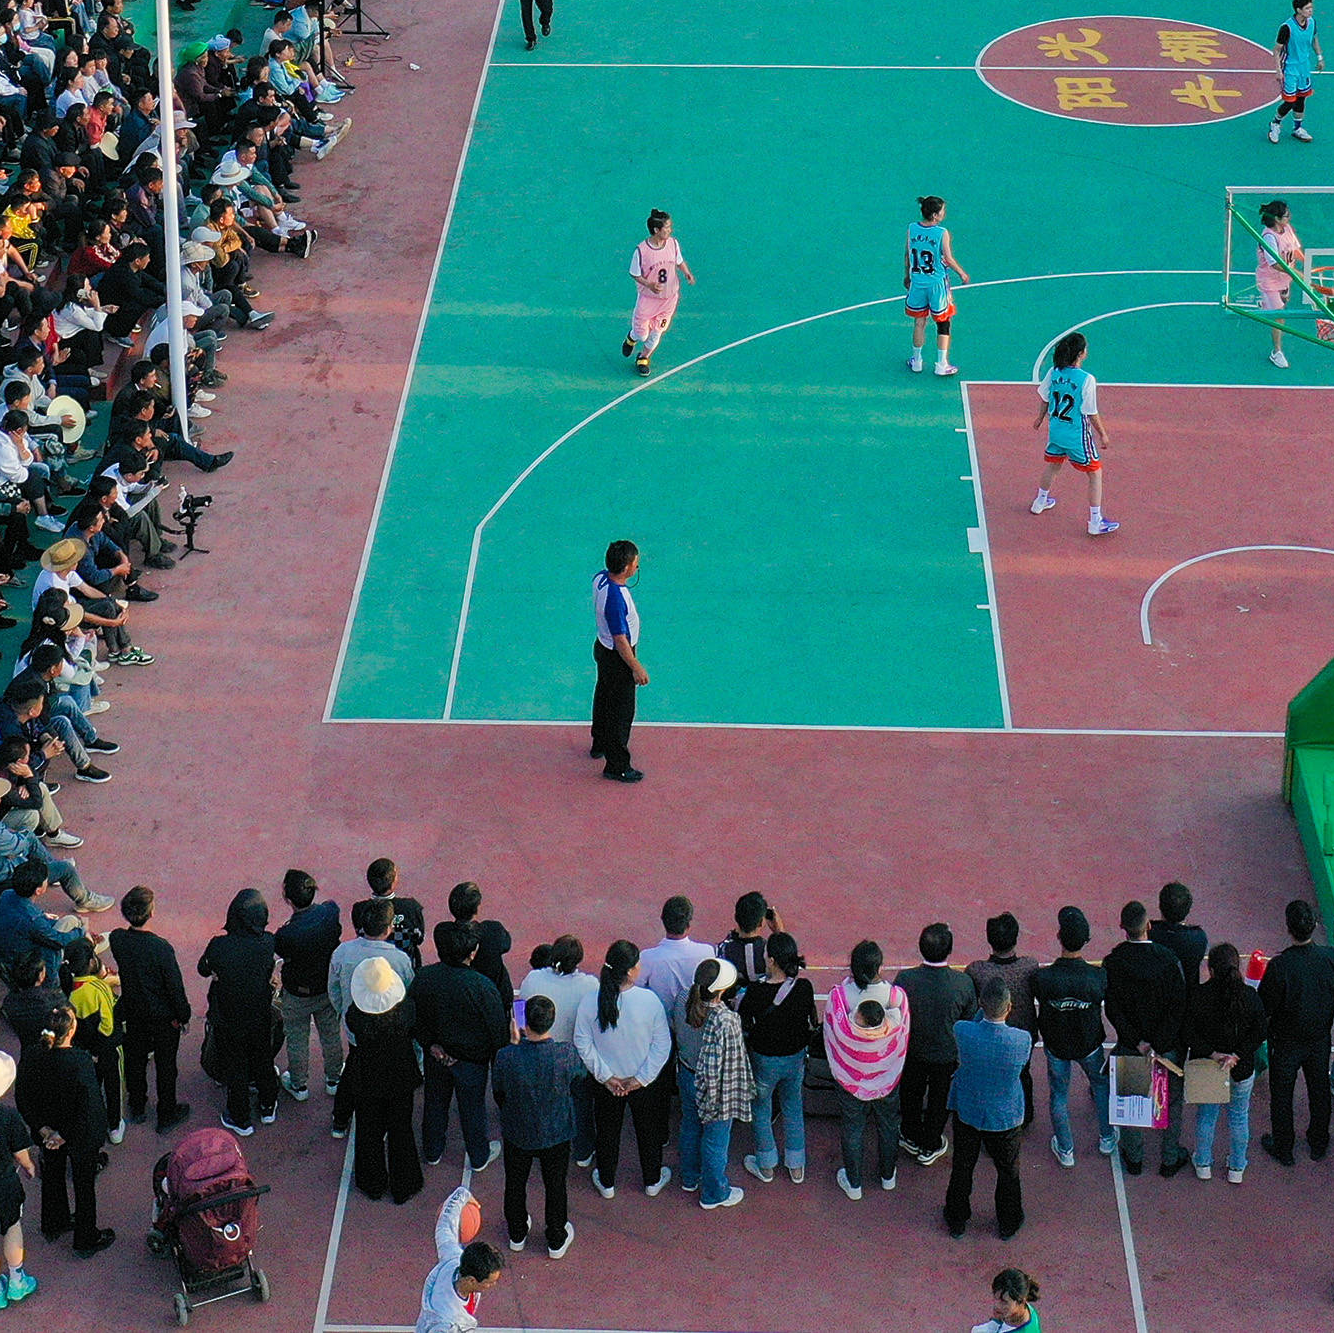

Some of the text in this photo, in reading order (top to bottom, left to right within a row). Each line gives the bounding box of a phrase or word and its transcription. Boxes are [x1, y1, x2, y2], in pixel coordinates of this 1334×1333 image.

[911, 248, 936, 275] 13
[658, 268, 668, 284] 8
[1051, 390, 1075, 424] 12
